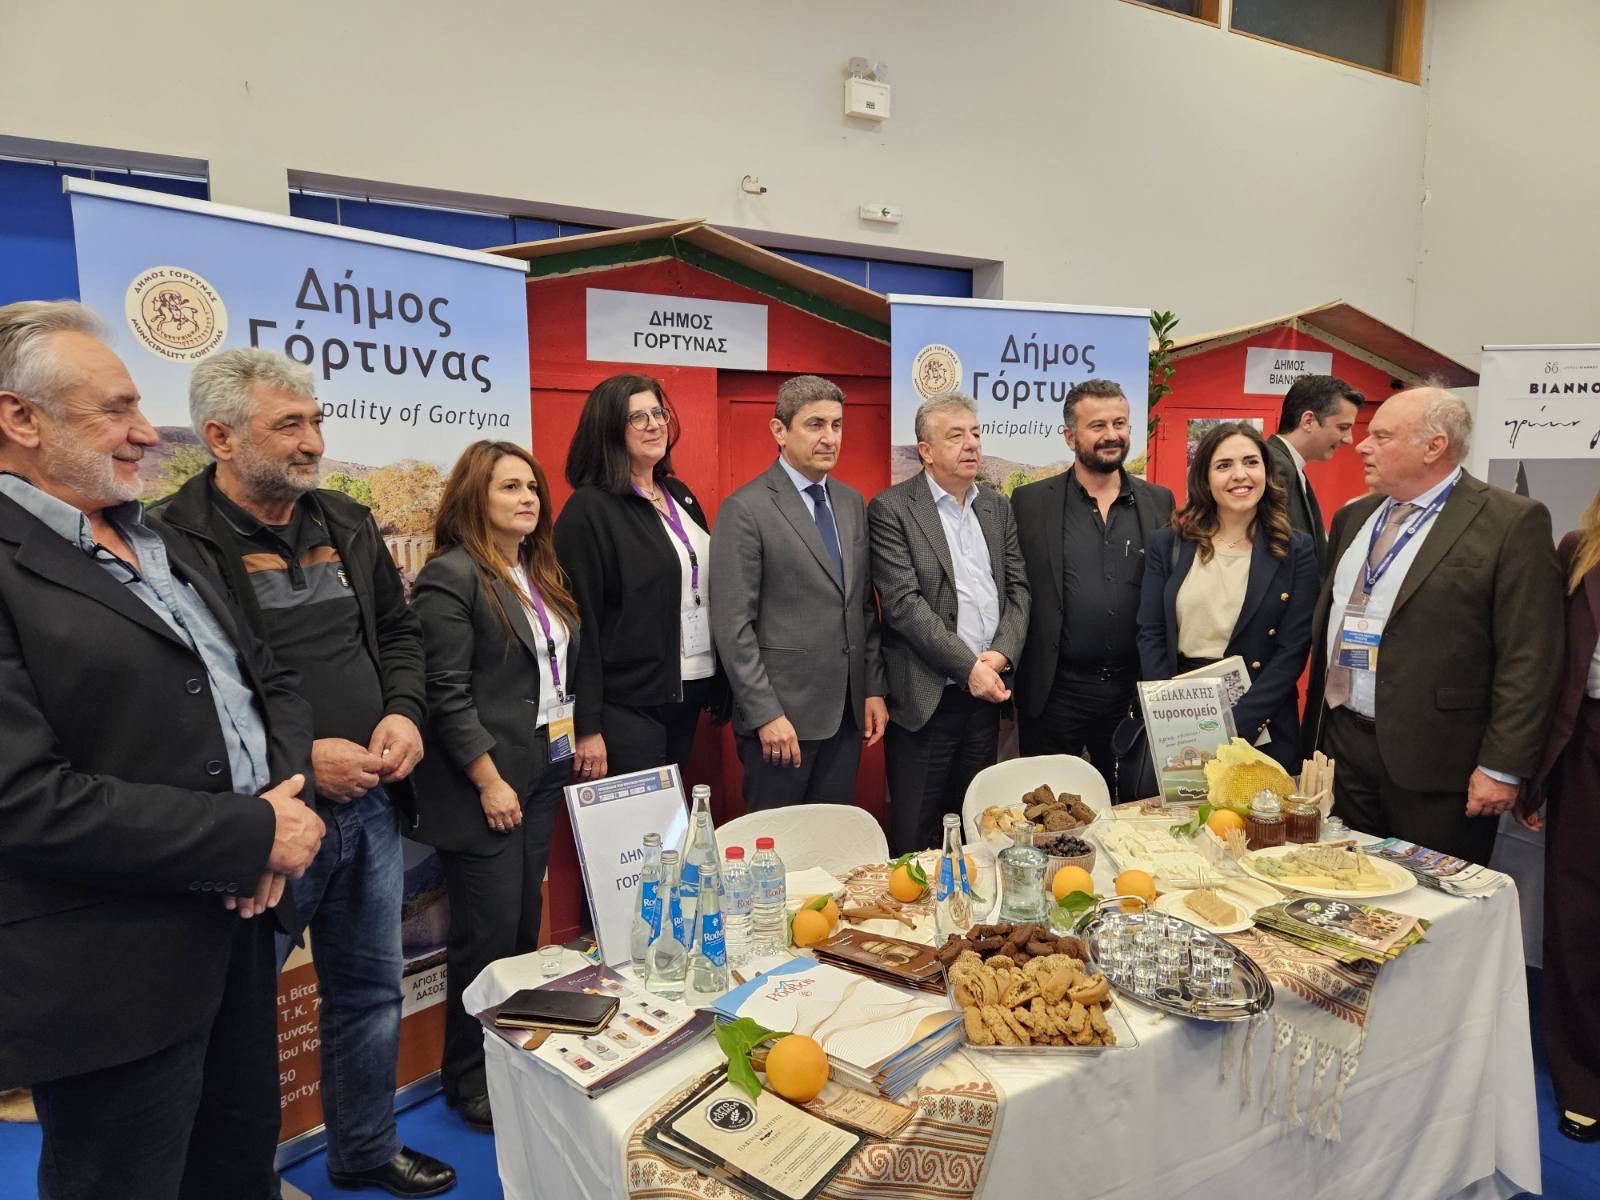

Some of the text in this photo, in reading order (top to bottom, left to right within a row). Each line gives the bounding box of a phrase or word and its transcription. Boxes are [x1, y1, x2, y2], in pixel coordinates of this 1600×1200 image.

[134, 270, 217, 303] ΔΗΜΟΣ ΓΟΡΤΥΝΑΣ
[296, 267, 451, 338] Δήμος
[649, 310, 713, 330] ΔΗΜΟΣ
[131, 318, 186, 359] MUNICIPALITY
[633, 332, 727, 353] ΓΟΡΤΥΝΑΣ
[249, 318, 491, 393] Γόρτυνας
[1000, 333, 1095, 373] Δήμος
[1274, 360, 1305, 371] ΔΗΜΟΣ
[1269, 373, 1298, 384] ΒΙΑΝΝ
[972, 370, 1074, 409] Γόρτυ
[399, 404, 422, 426] of
[429, 405, 510, 429] Gortyna
[980, 421, 1053, 438] nicipality
[1153, 704, 1217, 722] τυροκομείο
[616, 872, 641, 890] ΓΟΡ
[413, 972, 438, 990] ΑΓΙΟΣ
[416, 982, 445, 1000] ΔΑΣΟΣ
[281, 997, 322, 1022] Τ.Κ. 7
[303, 1038, 321, 1052] Κρ
